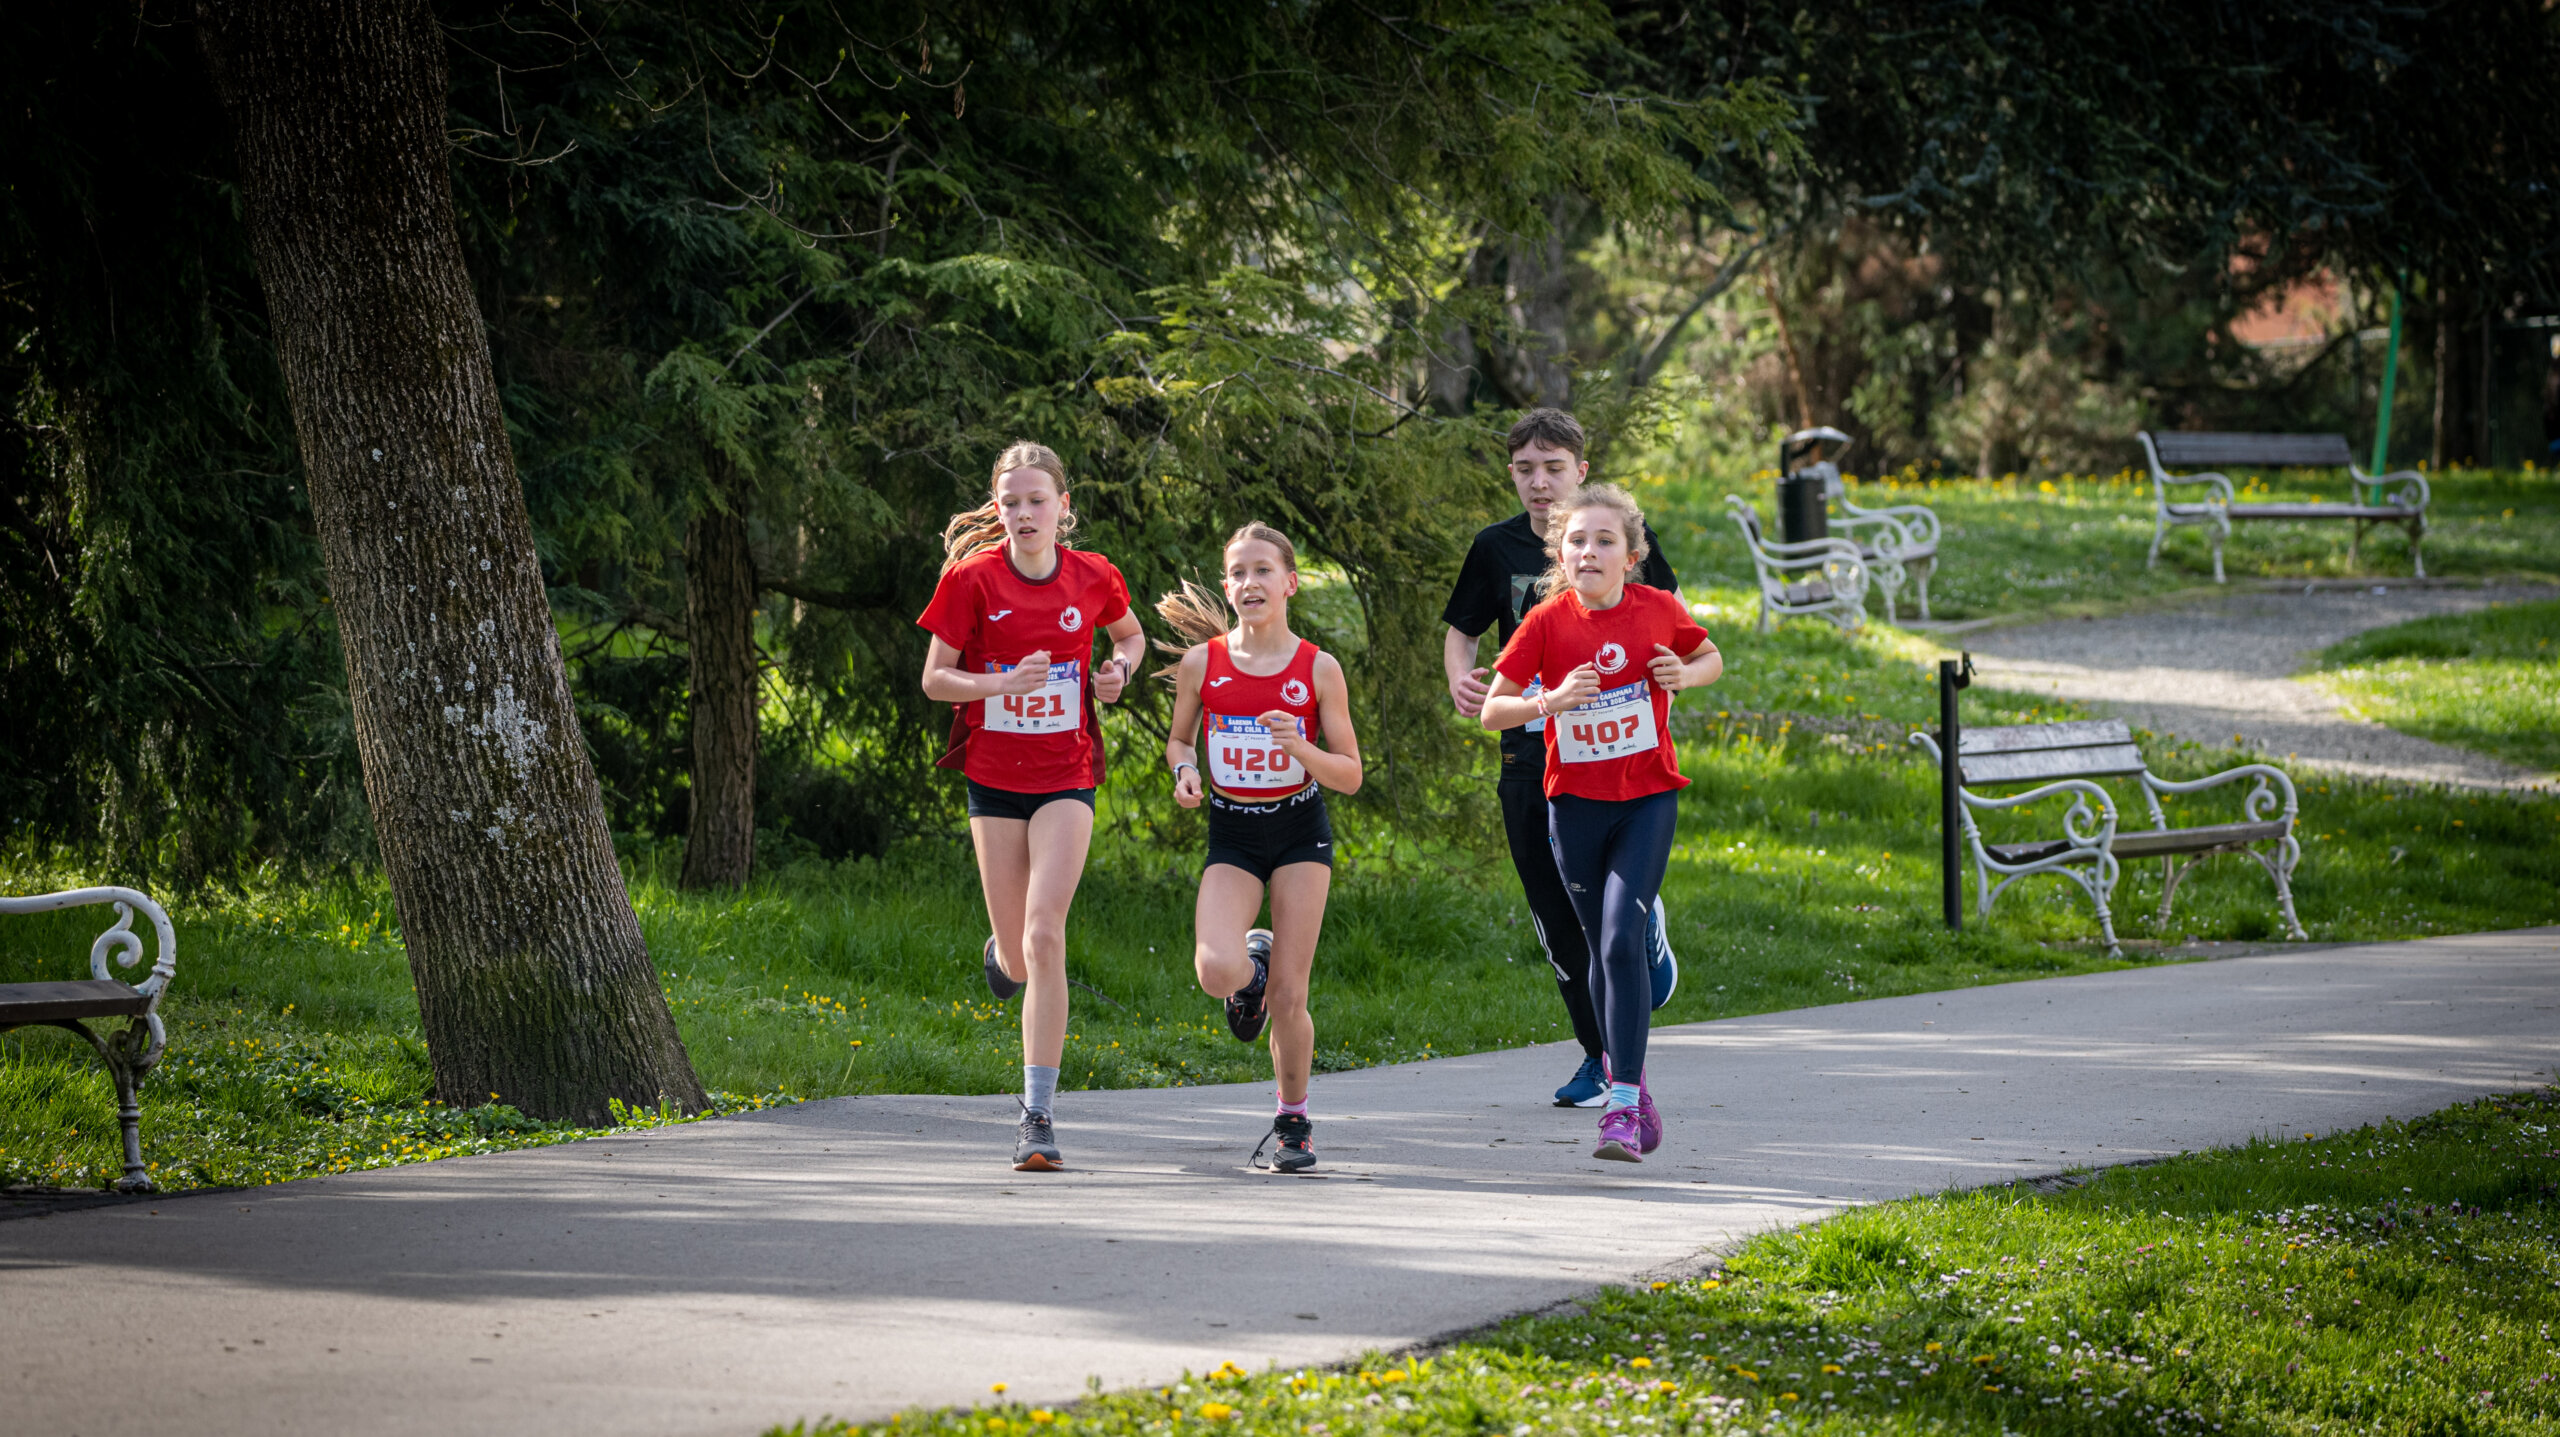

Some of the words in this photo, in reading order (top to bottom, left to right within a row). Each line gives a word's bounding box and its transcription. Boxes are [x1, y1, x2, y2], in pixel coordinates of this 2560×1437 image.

[1003, 694, 1065, 718] 421
[1233, 725, 1243, 733] DO
[1572, 714, 1640, 746] 407
[1223, 747, 1291, 772] 420
